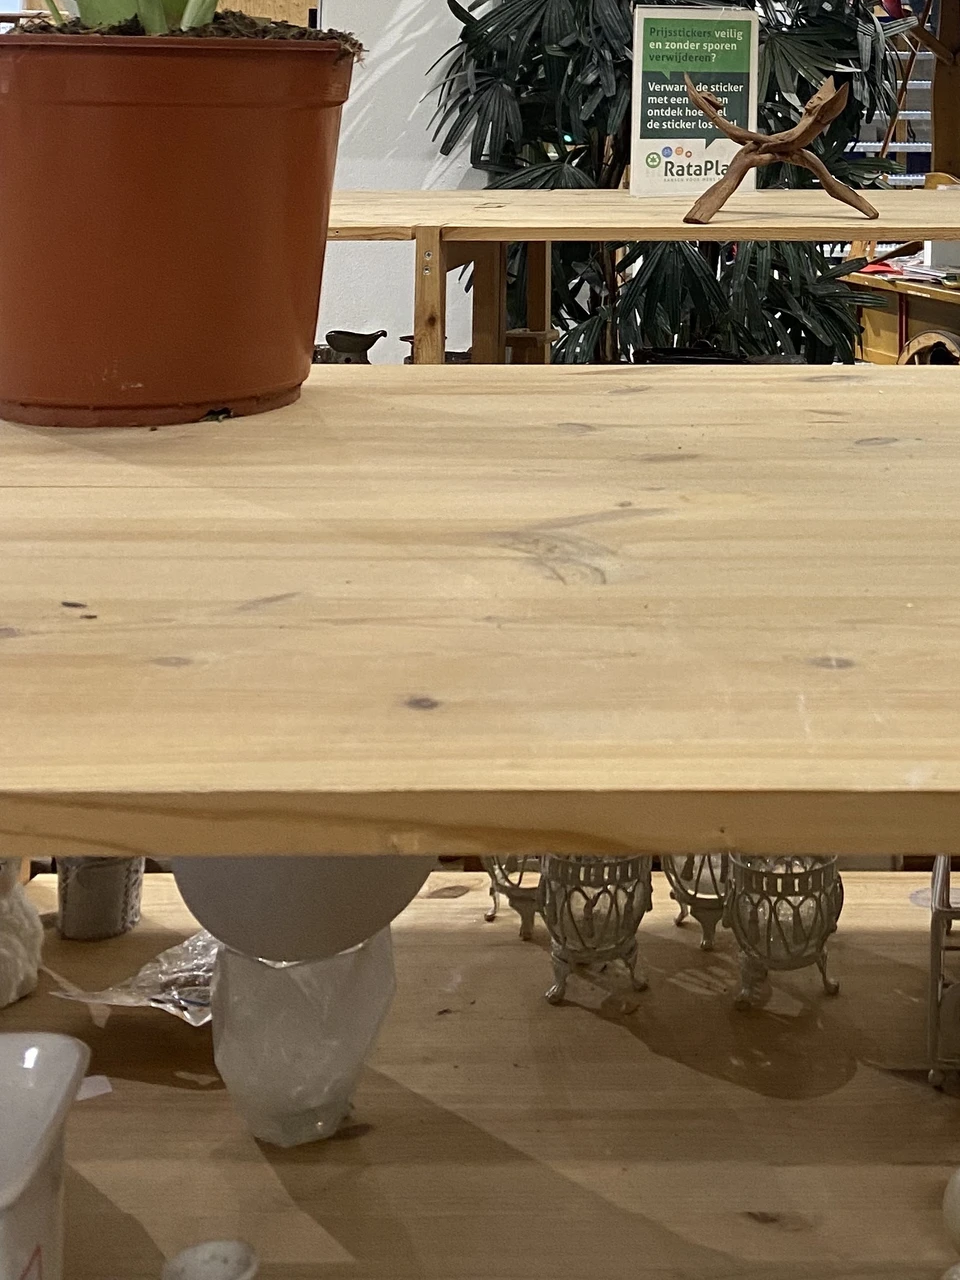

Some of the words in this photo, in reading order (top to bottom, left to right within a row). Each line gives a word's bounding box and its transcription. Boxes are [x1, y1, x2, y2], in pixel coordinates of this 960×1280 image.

[649, 27, 712, 38] Prijsstickers
[714, 28, 744, 41] veilig
[649, 41, 662, 49] en
[665, 40, 700, 50] zonder
[702, 42, 737, 52] sporen
[649, 53, 717, 63] verwijderen?
[696, 82, 708, 92] de
[710, 82, 744, 92] sticker
[647, 96, 668, 104] met
[647, 107, 683, 116] ontdek
[685, 107, 705, 116] hoe
[647, 119, 660, 129] de
[662, 119, 696, 129] sticker
[698, 119, 713, 129] los
[664, 160, 729, 176] RataPla
